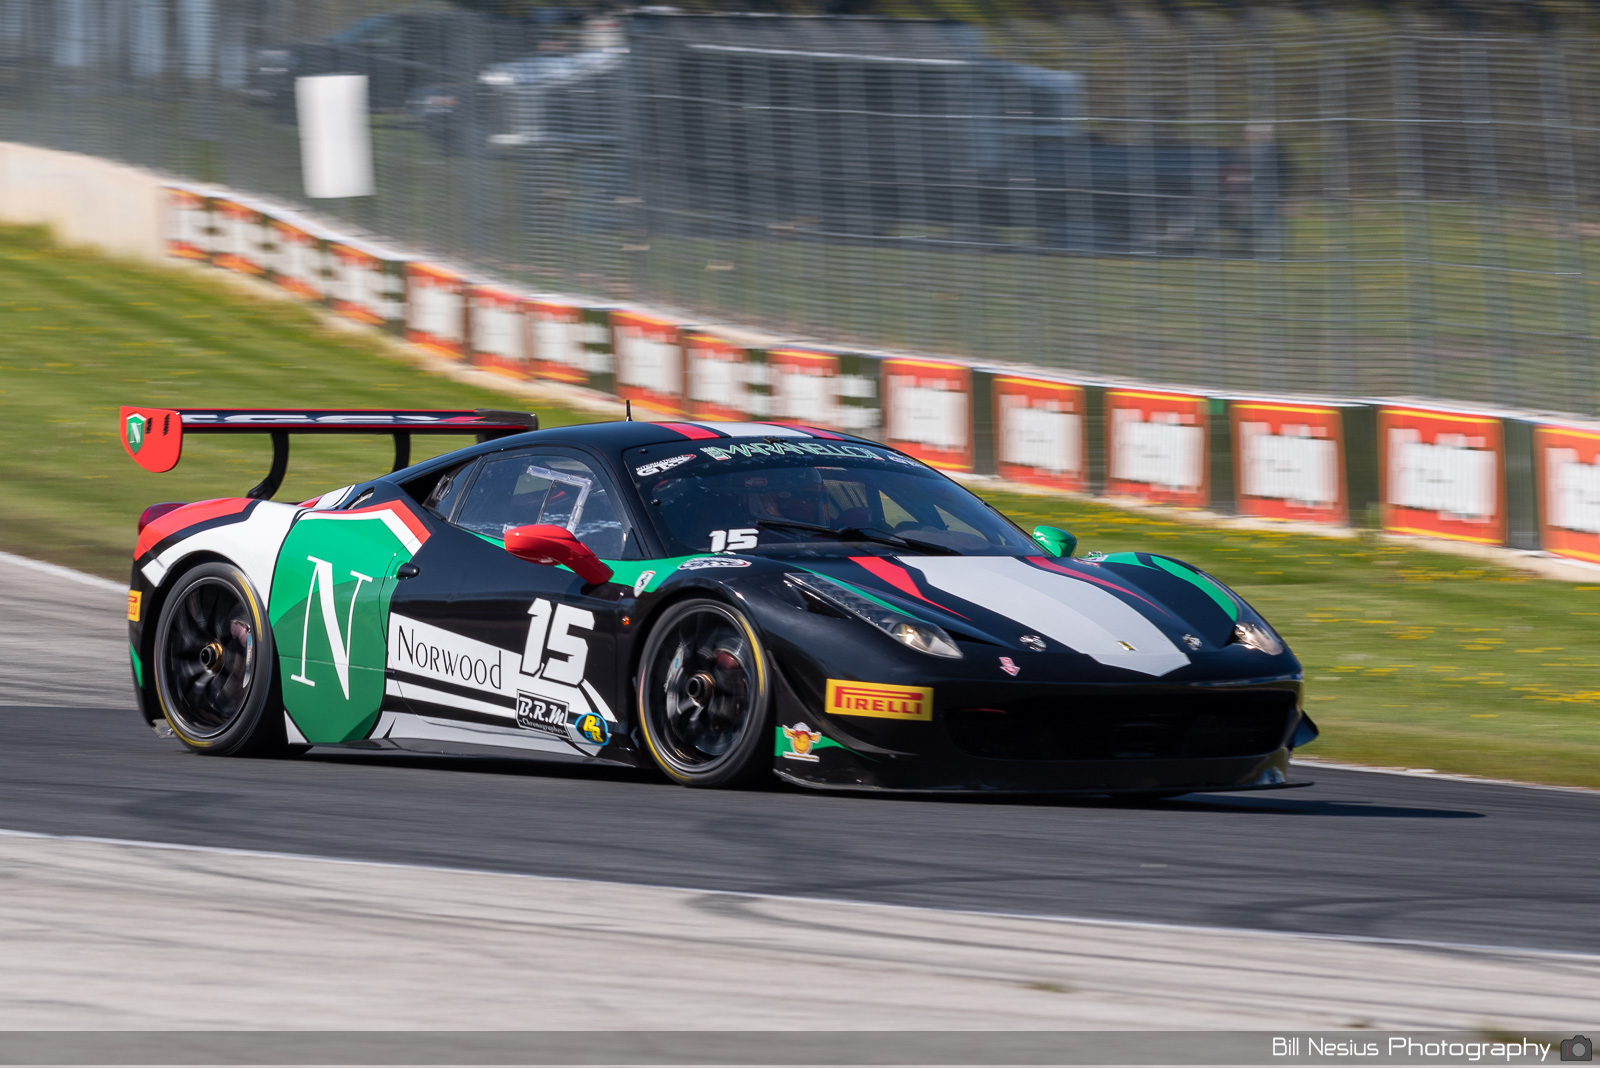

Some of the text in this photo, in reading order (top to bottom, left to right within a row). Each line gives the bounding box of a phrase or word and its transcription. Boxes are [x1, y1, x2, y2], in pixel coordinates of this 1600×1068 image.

[128, 422, 143, 444] N
[636, 455, 685, 472] INTERNATIONAL
[709, 528, 759, 553] 15
[291, 555, 373, 700] N
[520, 597, 595, 686] 15
[834, 686, 924, 715] PIRELLI
